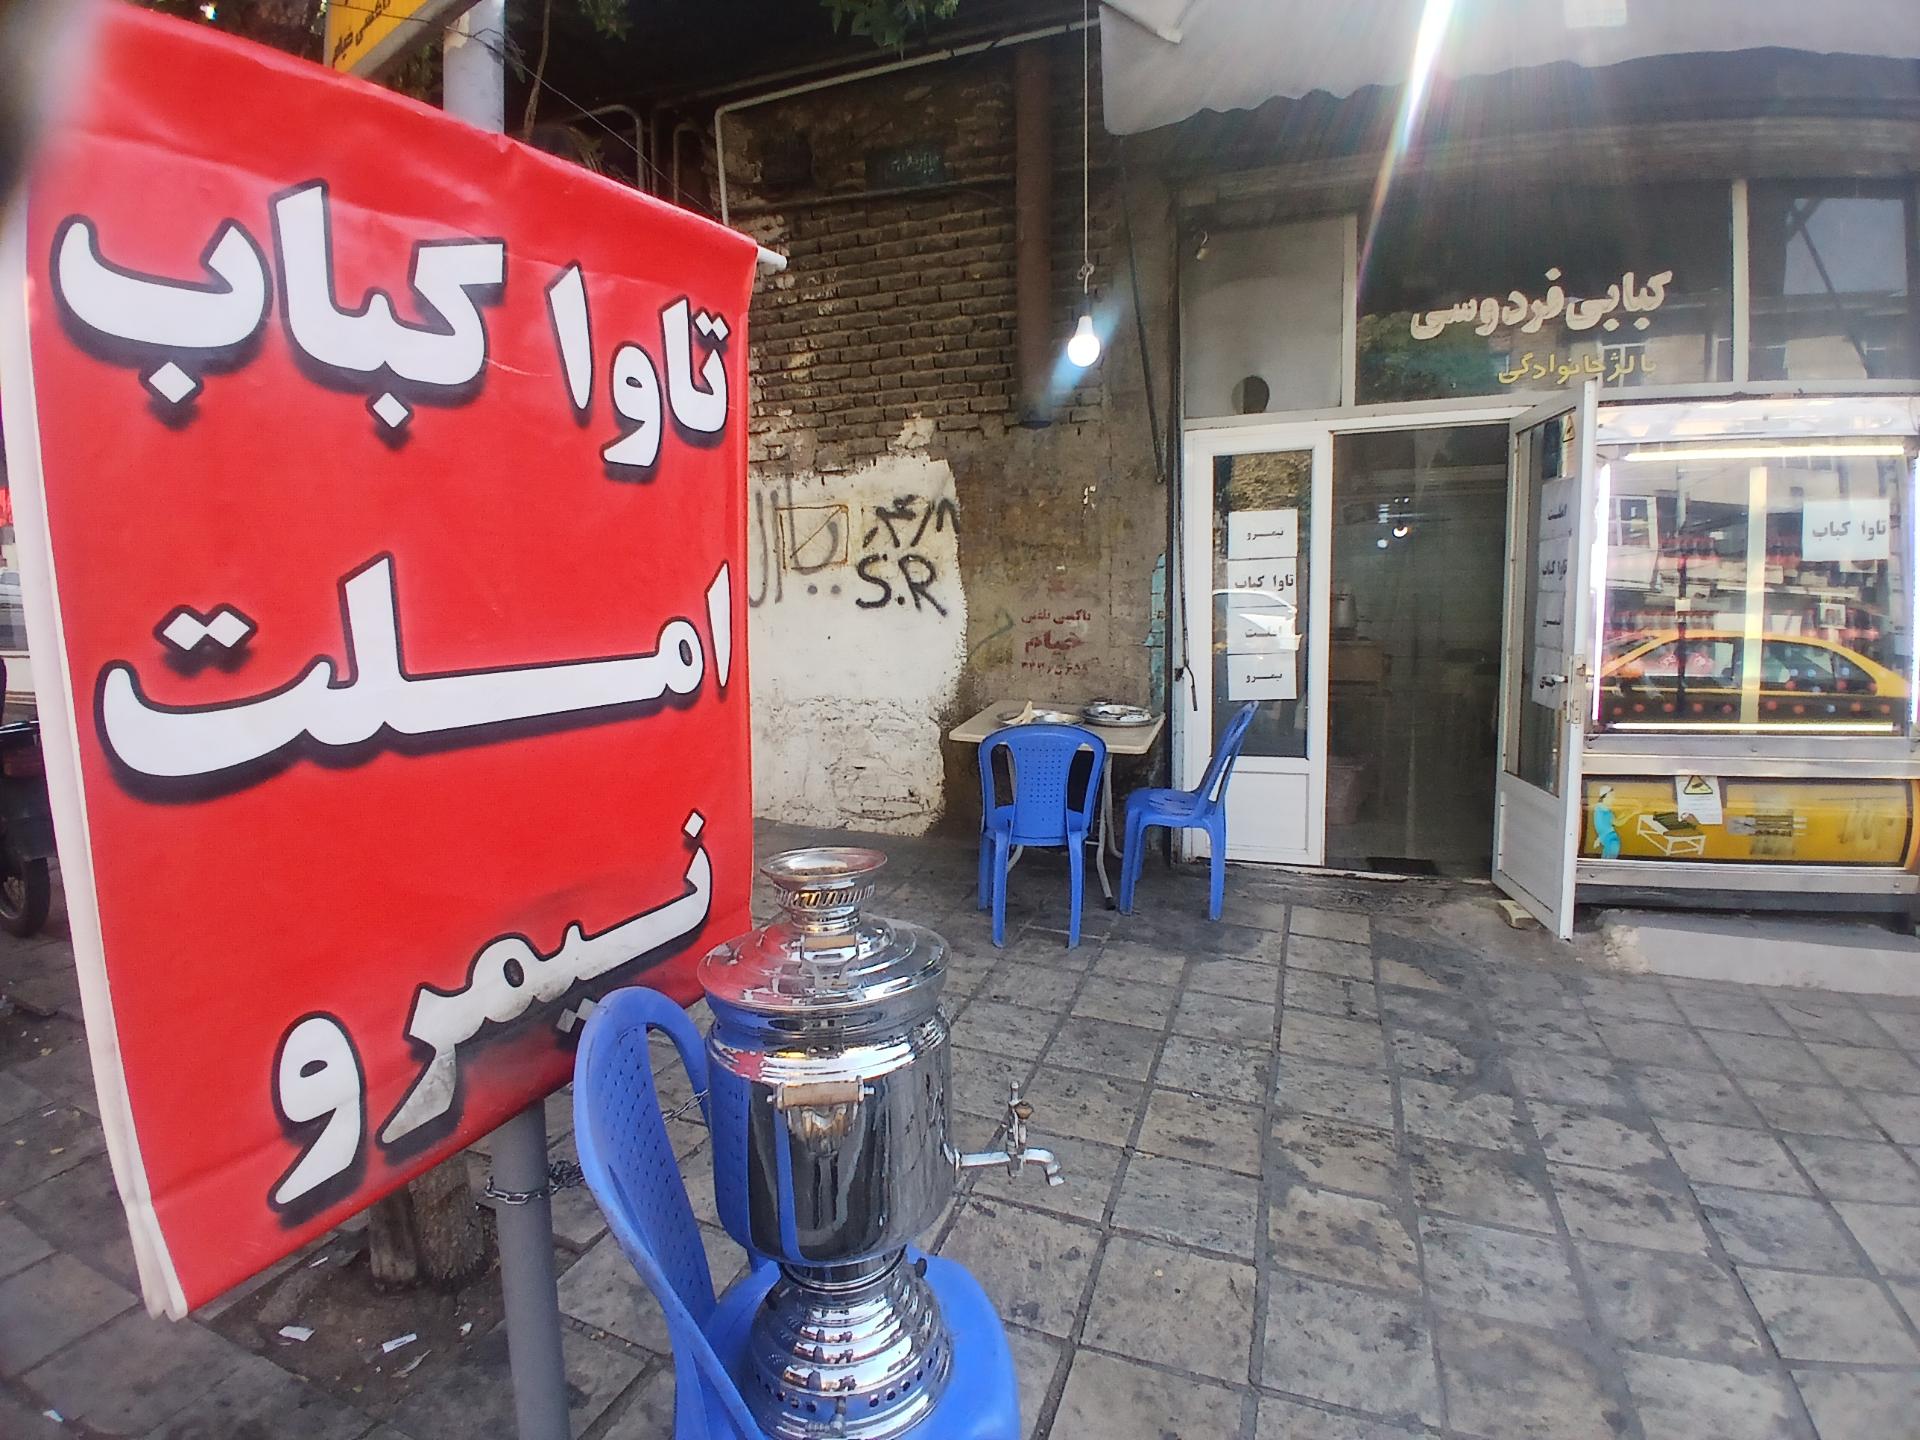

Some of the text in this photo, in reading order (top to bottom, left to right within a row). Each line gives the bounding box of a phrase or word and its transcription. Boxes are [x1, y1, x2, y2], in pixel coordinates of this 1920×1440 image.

[54, 181, 730, 468] تاوا کباب
[1409, 266, 1673, 341] کبابی فردوسی
[1234, 573, 1294, 592] تاوا کباب
[1811, 519, 1887, 542] تاوا کباب
[98, 552, 732, 779] املت
[274, 809, 712, 1205] نیمرو
